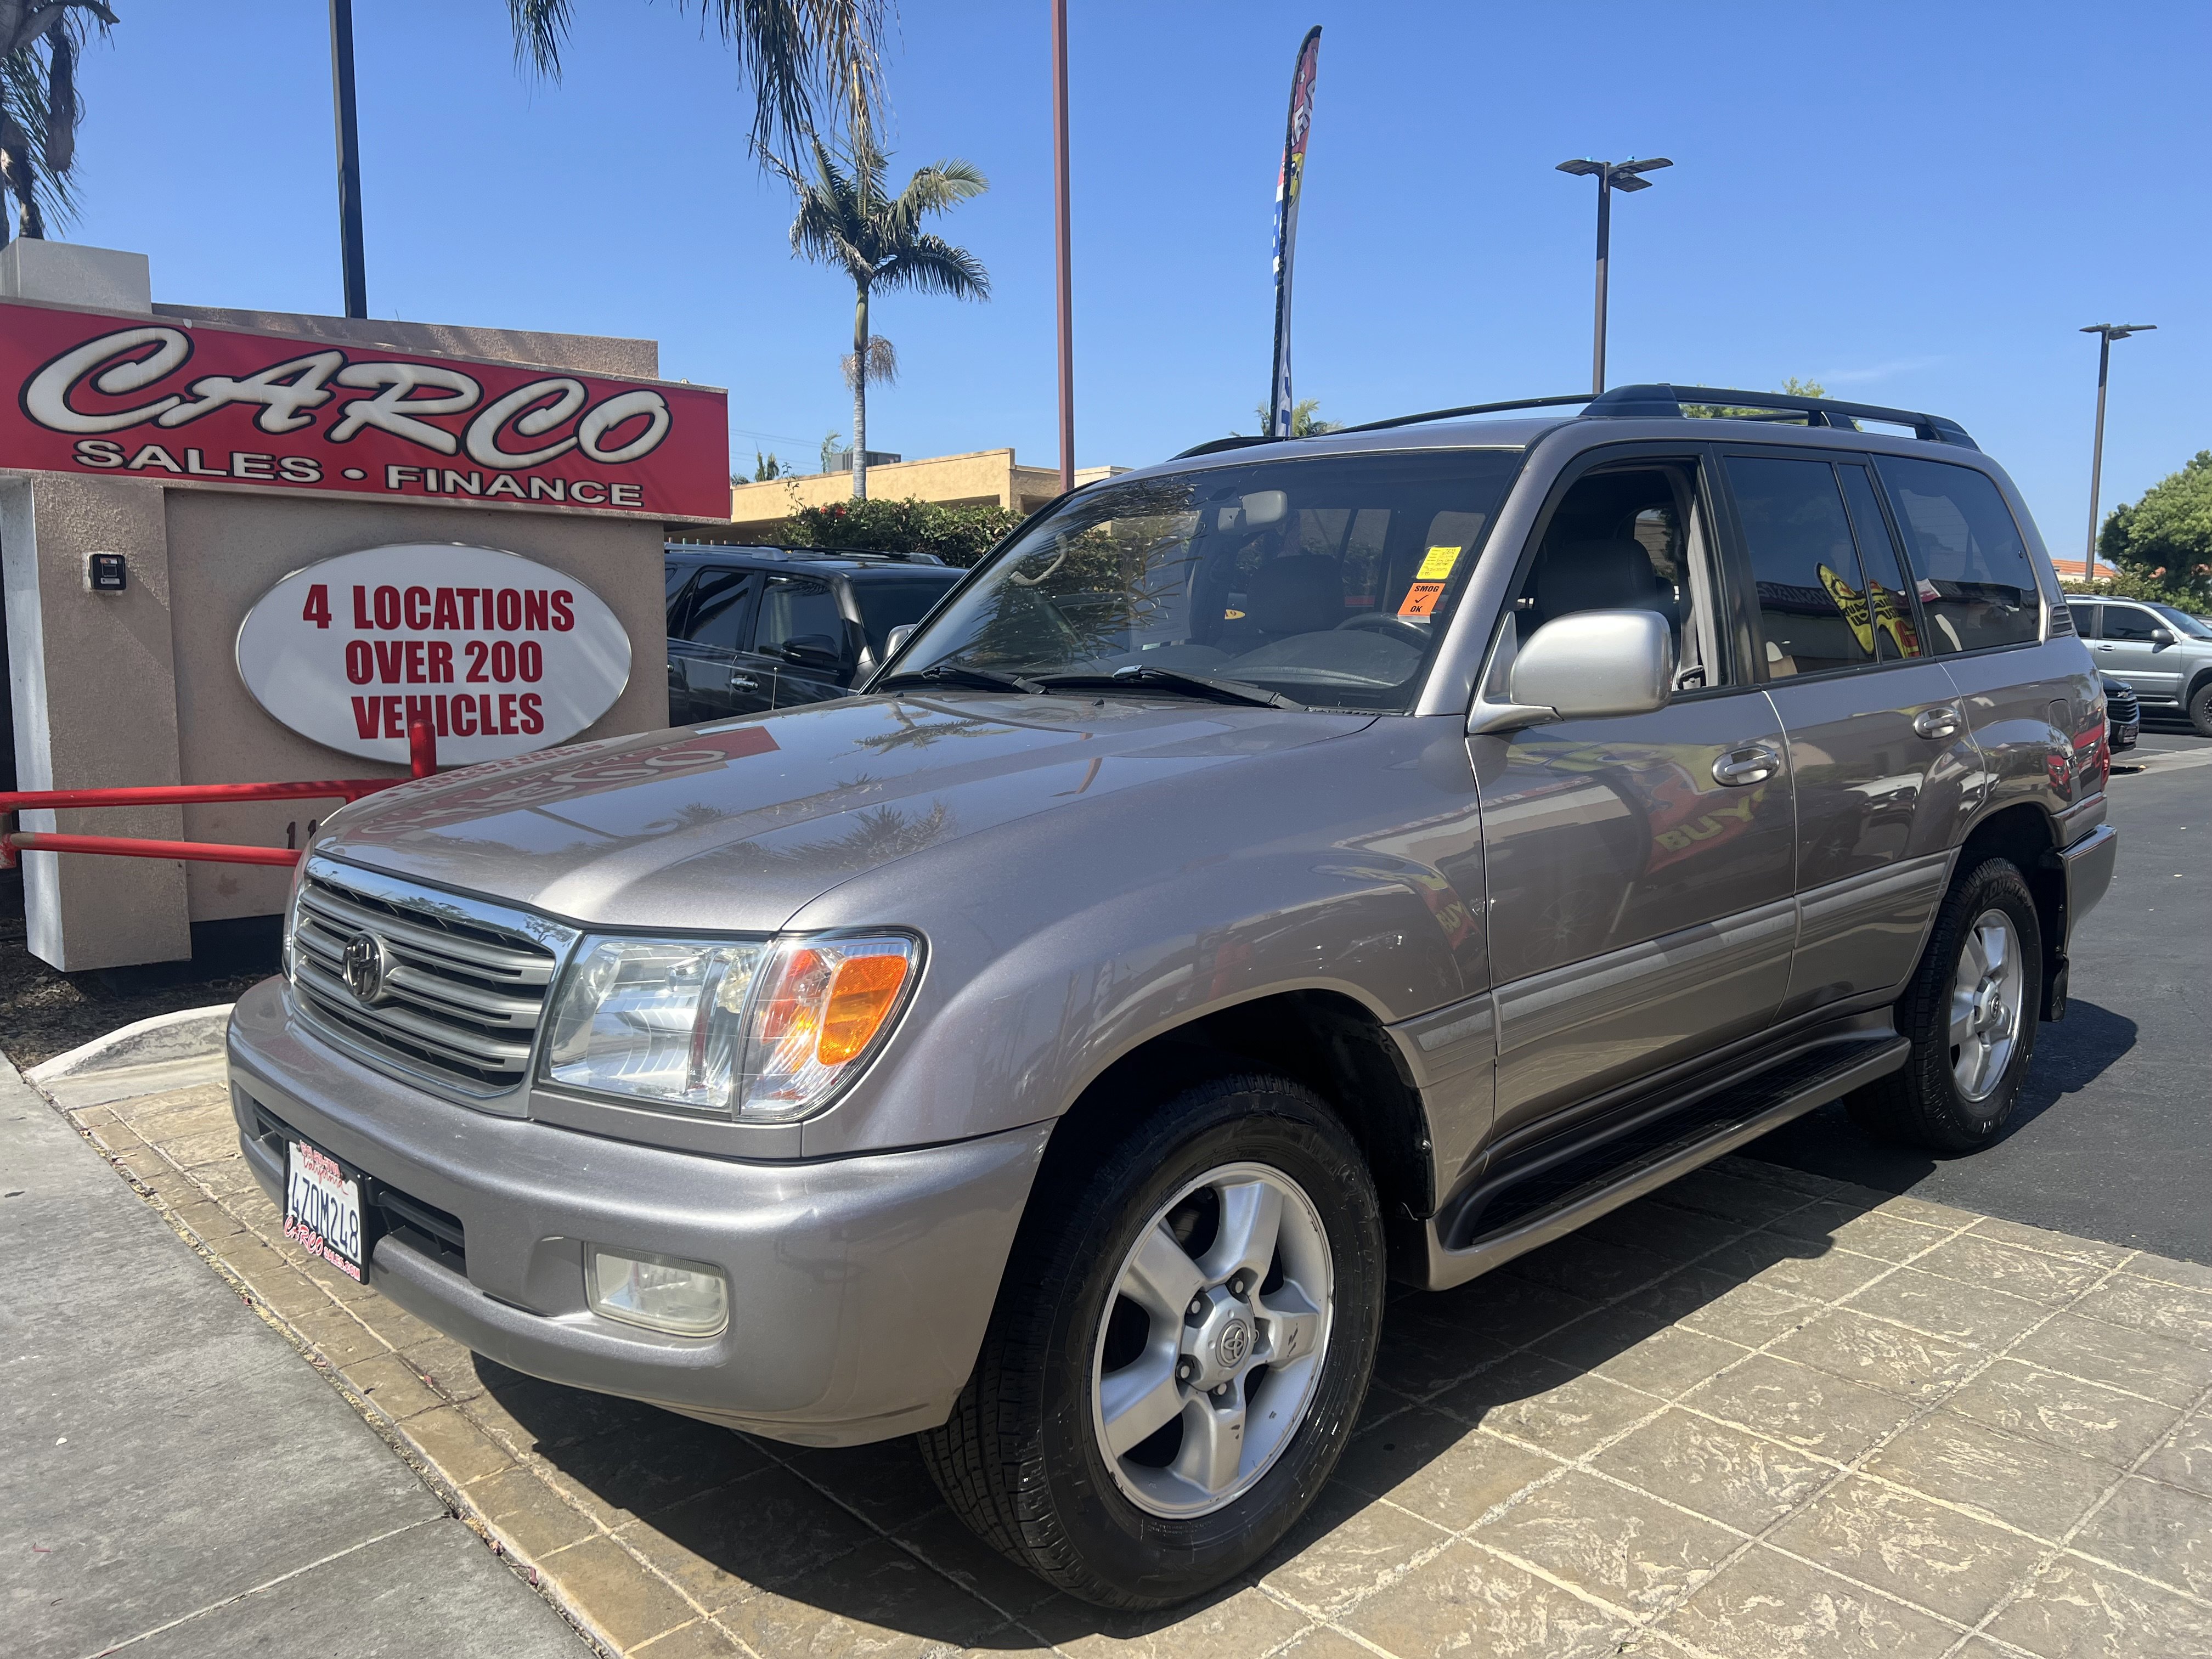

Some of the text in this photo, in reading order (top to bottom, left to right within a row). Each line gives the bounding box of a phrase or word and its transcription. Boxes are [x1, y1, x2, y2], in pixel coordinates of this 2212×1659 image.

[20, 326, 673, 470] CARCO
[73, 439, 645, 507] SALES FINANCE
[302, 584, 574, 632] 4 LOCATIONS
[346, 639, 543, 685] OVER 200
[352, 692, 544, 740] VEHICLES
[1654, 795, 1754, 852] BUY
